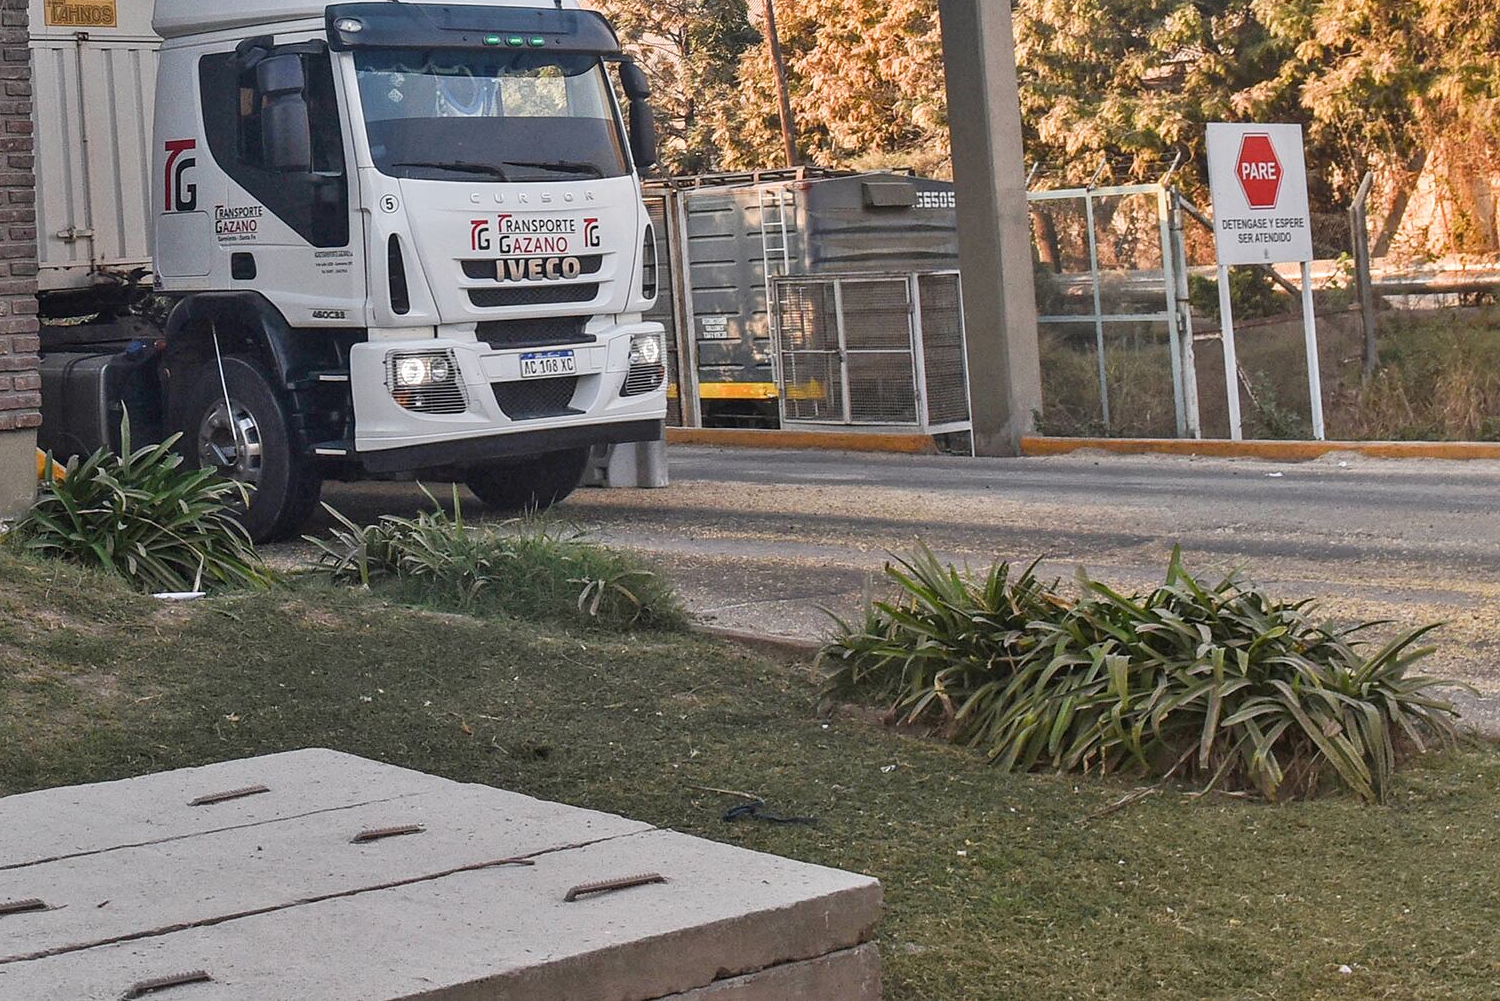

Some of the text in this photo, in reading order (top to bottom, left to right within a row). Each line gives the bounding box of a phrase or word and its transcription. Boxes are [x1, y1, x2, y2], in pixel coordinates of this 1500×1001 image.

[1241, 162, 1277, 180] PARE
[385, 197, 394, 211] 5
[470, 190, 595, 204] CURSOR
[215, 205, 263, 220] TRANSPORTE
[215, 219, 258, 234] GAZANO
[498, 214, 576, 233] TRANSPORTE
[1222, 217, 1304, 230] DETENGASE Y ESPERE
[500, 235, 568, 254] GAZANO
[1238, 232, 1291, 243] SER ATENDIDO
[495, 256, 580, 282] IVECO
[525, 358, 573, 374] AC 108 XC
